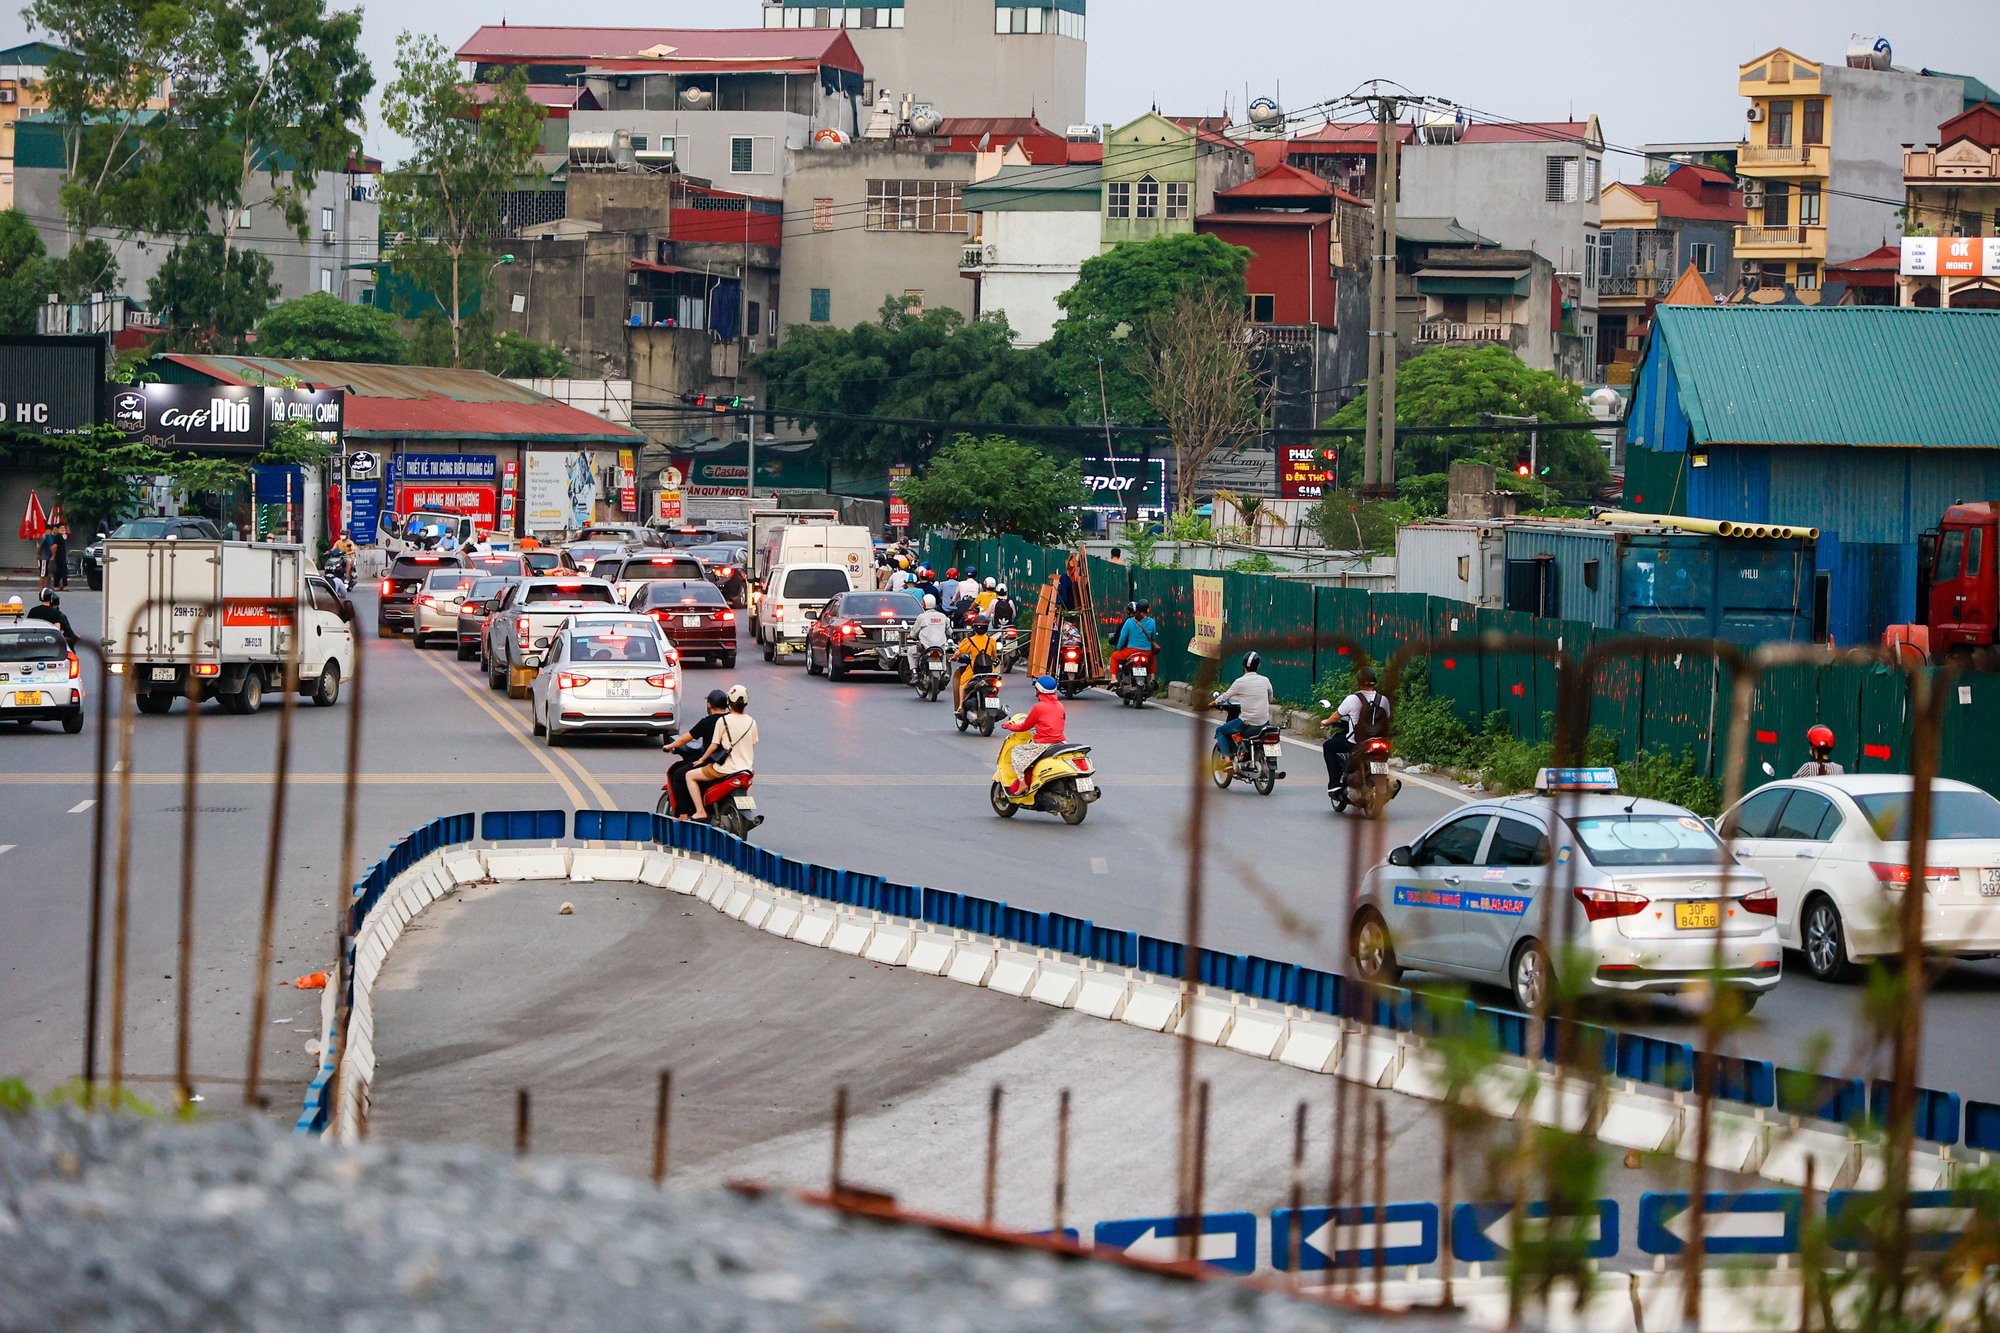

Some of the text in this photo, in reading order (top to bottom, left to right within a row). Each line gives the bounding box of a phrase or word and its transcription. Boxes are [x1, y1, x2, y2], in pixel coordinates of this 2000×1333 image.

[1950, 243, 1969, 256] OK
[1945, 261, 1974, 270] MONEY
[16, 402, 49, 424] HC
[160, 397, 250, 432] Café Phố
[889, 504, 910, 514] HOTEL
[233, 606, 264, 617] LALAMOVE
[1688, 904, 1706, 915] 30F
